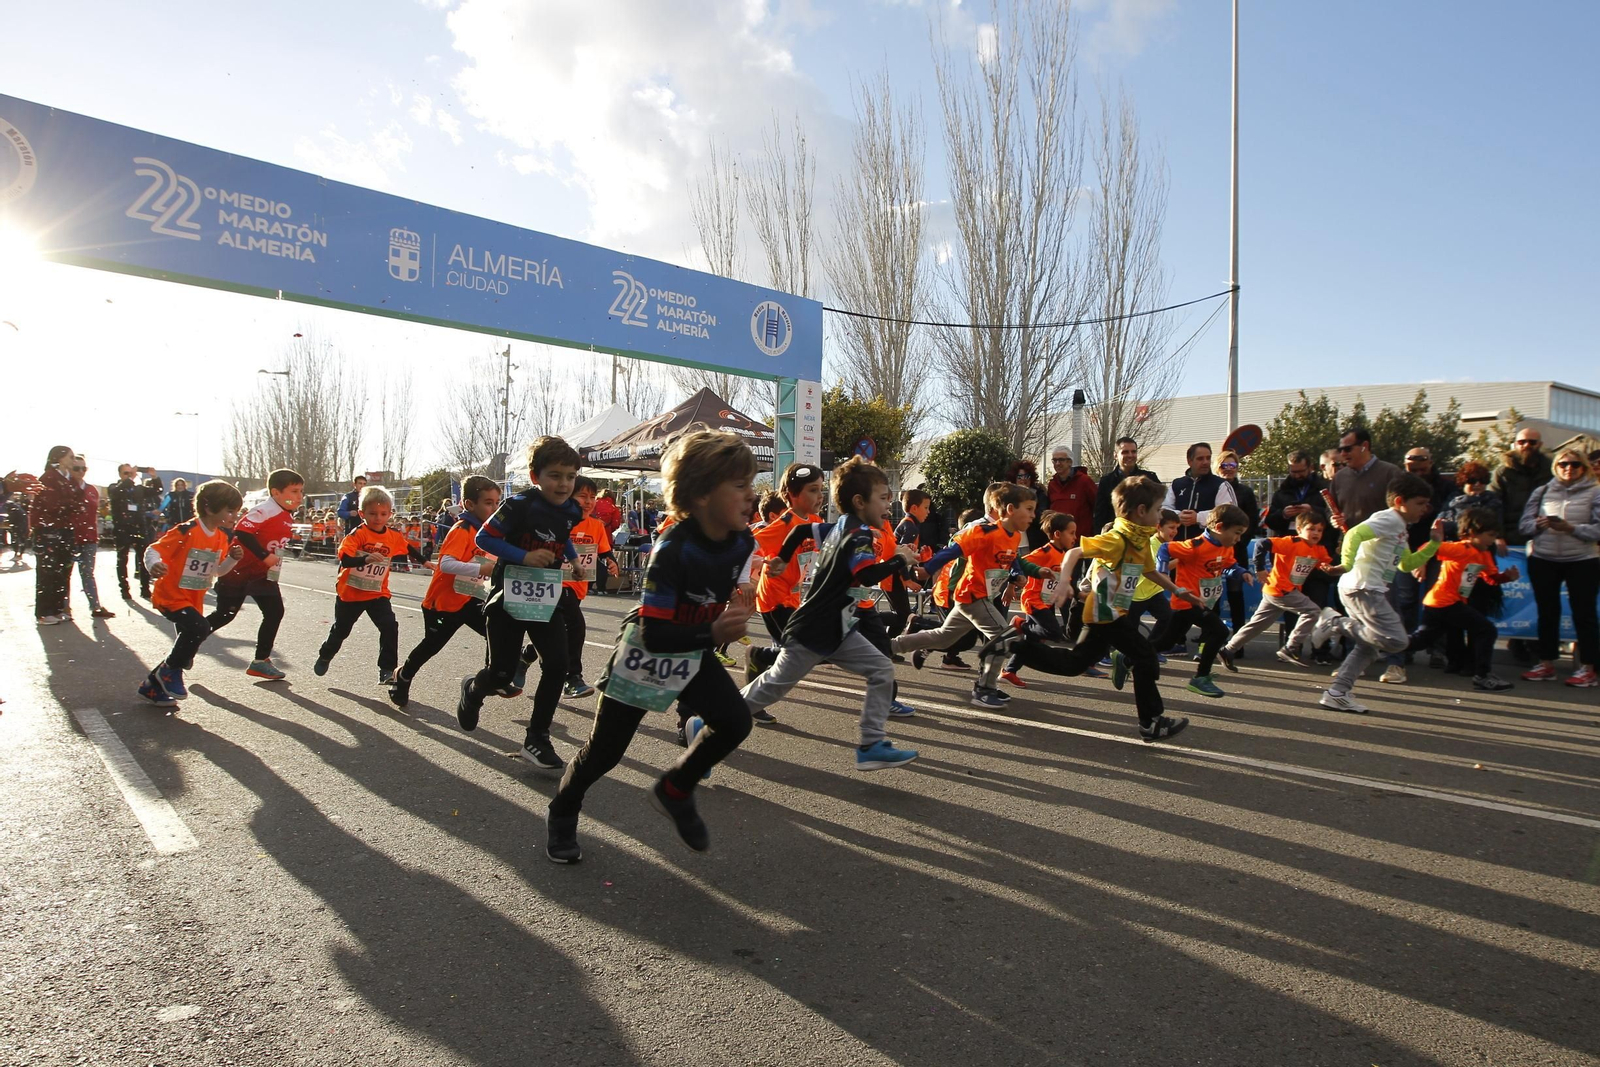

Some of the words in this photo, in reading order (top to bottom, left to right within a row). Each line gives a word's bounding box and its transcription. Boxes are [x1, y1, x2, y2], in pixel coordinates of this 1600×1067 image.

[219, 189, 292, 218] MEDIO
[218, 209, 327, 248] MARATÓN
[217, 231, 316, 263] ALMERÍA
[447, 244, 564, 289] ALMERÍA
[446, 270, 509, 295] CIUDAD
[657, 289, 697, 308] MEDIO
[656, 304, 716, 326] MARATÓN
[656, 319, 710, 339] ALMERÍA
[511, 580, 555, 598] 8351
[624, 648, 690, 680] 8404
